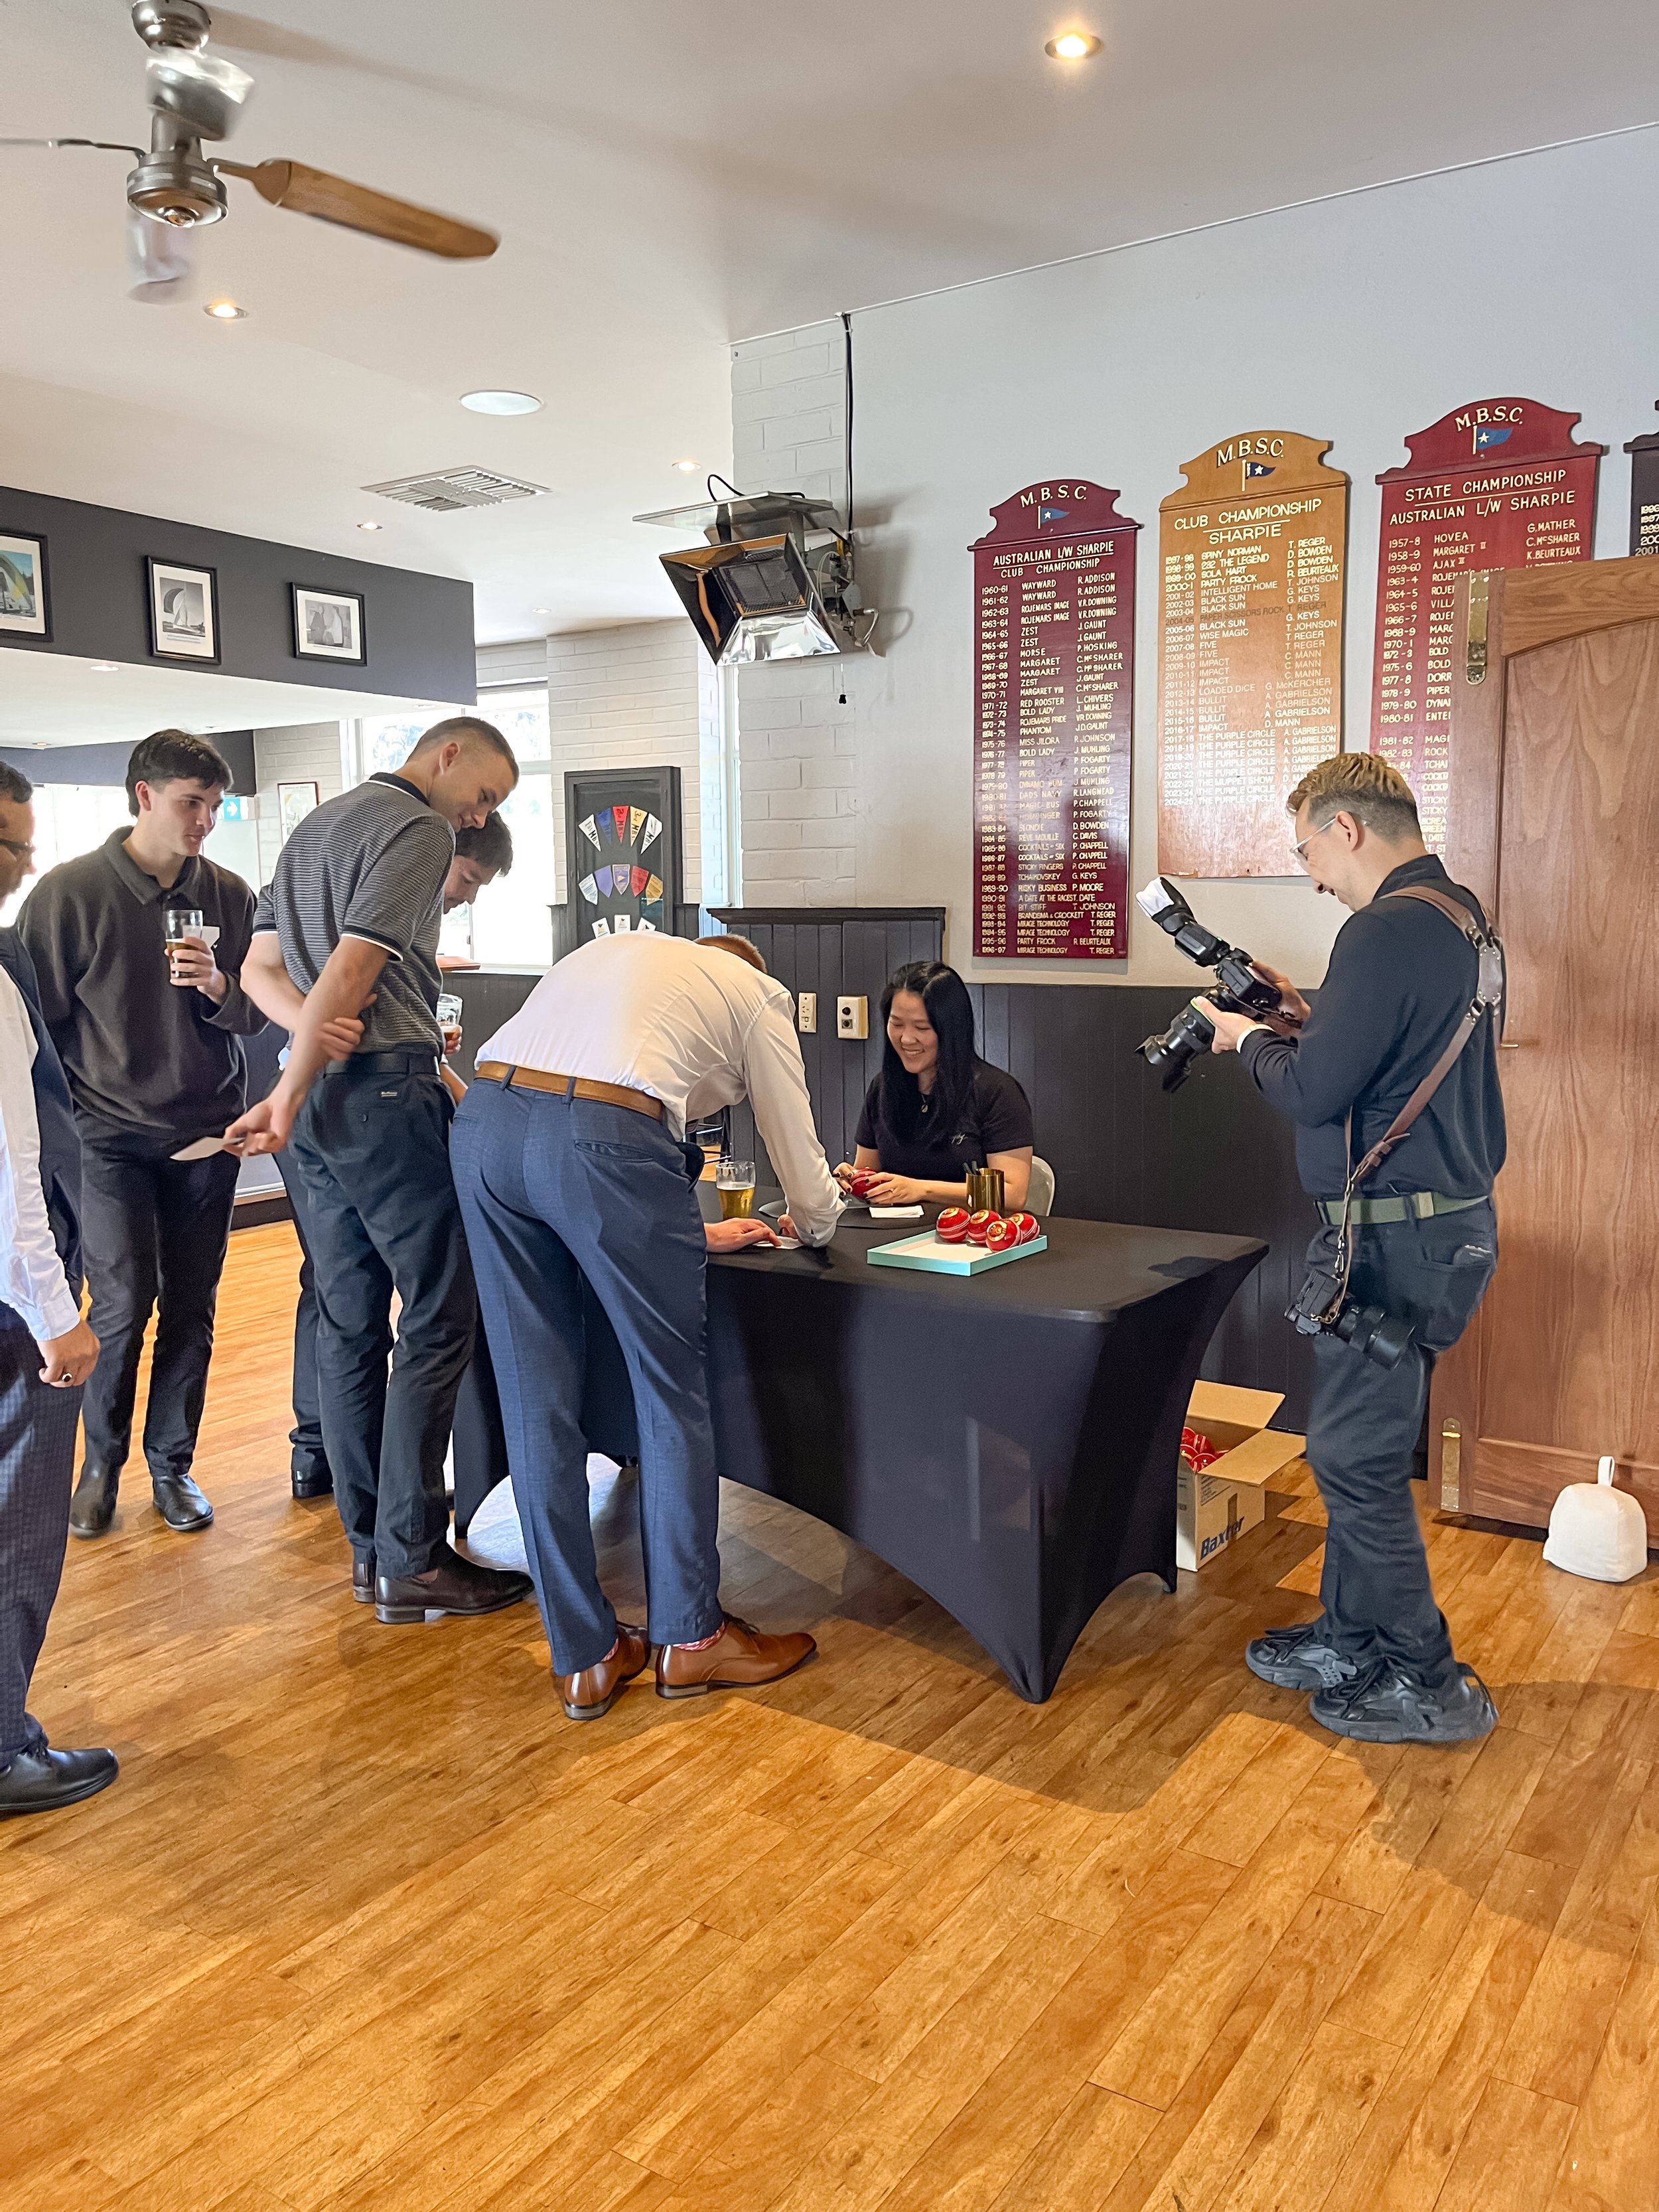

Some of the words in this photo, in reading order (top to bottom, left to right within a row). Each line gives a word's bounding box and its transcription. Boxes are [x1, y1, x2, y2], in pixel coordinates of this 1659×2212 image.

[1405, 484, 1451, 502] STATE
[1462, 469, 1565, 494] CHAMPIONSHIP
[1390, 505, 1465, 525] AUSTRALIAN
[1476, 496, 1501, 518] L/W
[1510, 490, 1575, 510] SHARPIE
[1175, 515, 1208, 530] CLUB
[1218, 498, 1321, 524] CHAMPIONSHIP
[1209, 524, 1281, 544] SHARPIE
[1389, 537, 1420, 548] 1957-8
[1434, 531, 1468, 543] HOVEA
[993, 549, 1050, 566] AUSTRALIAN
[1057, 545, 1072, 559] L/W
[1076, 540, 1114, 555] SHARPIE
[1220, 558, 1234, 567] THE
[1237, 553, 1269, 565] LEGEND
[1297, 545, 1331, 557] BOWDEN
[1227, 545, 1261, 556] NORMAN
[1388, 550, 1420, 561] 1958-9
[1433, 544, 1475, 557] MARGARET
[1297, 555, 1333, 567] BOWDEN
[1388, 562, 1421, 573] 1959-60
[1433, 559, 1455, 569] AJAX
[1001, 567, 1023, 578] CLUB
[1036, 557, 1100, 574] CHAMPIONSHIP
[1200, 584, 1251, 596] INTELLIGENT
[1253, 581, 1277, 590] HOME
[1297, 574, 1338, 585] JOHNSON
[1387, 575, 1418, 586] 1963-4
[981, 585, 1007, 595] 1960-61
[1021, 579, 1056, 590] WAYWARD
[981, 595, 1008, 606] 1961-62
[1022, 590, 1056, 601] WAYWARD
[1165, 599, 1193, 609] 2002-03
[1201, 595, 1226, 605] BLACK
[1298, 585, 1319, 593] KEYS
[1386, 589, 1417, 599] 1964-5
[1165, 608, 1193, 617] 2003-04
[1200, 604, 1226, 613] BLACK
[1298, 593, 1319, 602] KEYS
[1385, 602, 1417, 612] 1965-6
[981, 607, 1009, 617] 1962-63
[981, 619, 1008, 628] 1963-64
[1165, 625, 1194, 634] 2005-06
[1200, 621, 1226, 630] BLACK
[1297, 611, 1319, 620] KEYS
[1385, 615, 1417, 625] 1966-7
[981, 629, 1008, 639] 1964-65
[1021, 627, 1038, 635] ZEST
[1165, 634, 1194, 643] 2006-07
[1199, 631, 1220, 640] WISE
[1222, 628, 1248, 637] MAGIC
[1294, 620, 1336, 630] JOHNSON
[1384, 627, 1416, 637] 1968-9
[981, 640, 1008, 650] 1965-66
[1020, 638, 1039, 646] ZEST
[1165, 643, 1194, 652] 2007-08
[1294, 630, 1323, 640] REGER
[1294, 640, 1325, 649] REGER
[981, 652, 1007, 660] 1966-67
[1020, 648, 1045, 657] MORSE
[1429, 646, 1448, 655] BOLD
[981, 662, 1007, 671] 1967-68
[1020, 657, 1060, 668] MARGARET
[1199, 658, 1229, 667] IMPACT
[1295, 650, 1321, 658] MANN
[1427, 659, 1451, 669] BOLD
[1020, 667, 1060, 678] MARGARET
[1199, 667, 1229, 676] IMPACT
[1295, 660, 1321, 668] MANN
[1199, 677, 1228, 686] IMPACT
[1295, 669, 1321, 678] MANN
[1020, 687, 1050, 696] MARGARET
[1199, 686, 1232, 695] LOADED
[1236, 684, 1255, 692] DICE
[1275, 688, 1332, 698] GABRIELSON
[1426, 686, 1450, 695] PIPER
[1035, 697, 1064, 706] ROOSTER
[1381, 700, 1416, 710] 1979-80
[1275, 707, 1330, 717] GABRIELSON
[1380, 713, 1413, 723] 1980-81
[1019, 726, 1051, 735] PHANTOM
[1199, 723, 1228, 731] IMPACT
[1198, 733, 1214, 741] THE
[1215, 731, 1245, 740] PURPLE
[1247, 729, 1275, 737] CIRCLE
[1380, 736, 1413, 745] 1981-82
[1247, 738, 1275, 747] CIRCLE
[1081, 745, 1110, 753] MUHLING
[1425, 747, 1448, 756] ROCK
[1081, 755, 1110, 763] FOGARTY
[1080, 765, 1110, 774] FOGARTY
